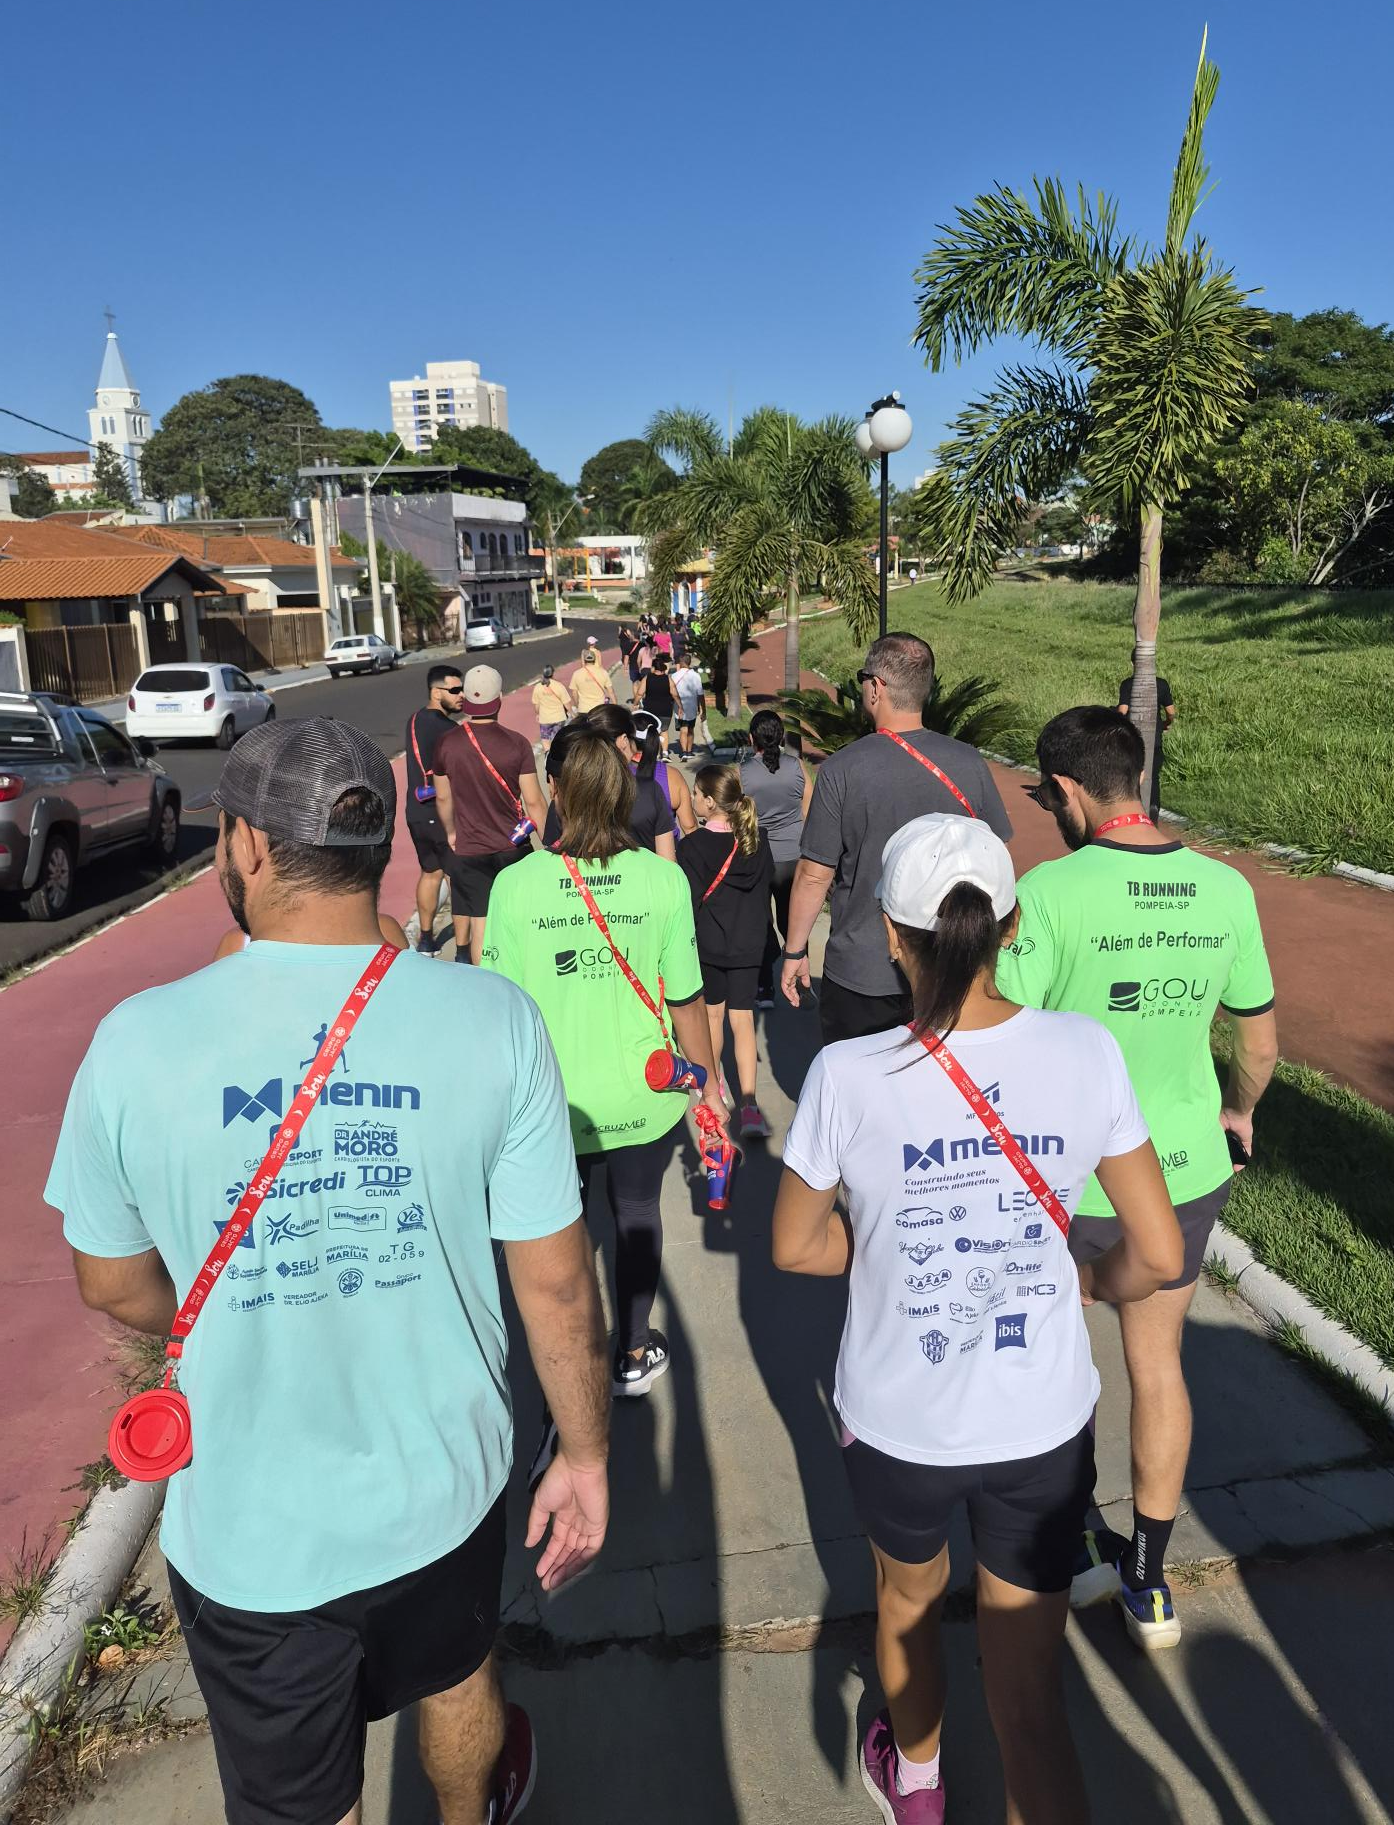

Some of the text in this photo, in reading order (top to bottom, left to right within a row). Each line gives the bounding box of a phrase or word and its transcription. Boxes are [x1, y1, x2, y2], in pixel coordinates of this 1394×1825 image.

[558, 878, 572, 890] TB
[575, 874, 622, 889] UNNING
[1127, 881, 1197, 897] TB RUNNING
[566, 888, 614, 898] POMEIA-SP
[1134, 901, 1190, 910] POMPEIA-SP
[570, 914, 585, 926] de
[1137, 933, 1153, 949] de
[1143, 978, 1209, 1002] GOU
[350, 1130, 398, 1142] ANDRÉ
[334, 1140, 399, 1157] MORO
[357, 1165, 412, 1182] TOP
[904, 1169, 987, 1186] Construindo seus
[365, 1188, 401, 1197] CLIMA
[904, 1177, 1000, 1195] melhores momentos
[333, 1211, 368, 1221] Unimed
[895, 1217, 944, 1230] comasa
[289, 1218, 320, 1231] Padilha
[326, 1248, 369, 1263] MARÍLIA
[375, 1273, 422, 1287] Passaport
[908, 1271, 949, 1288] JAZAM
[283, 1291, 317, 1300] VEREADOR
[1026, 1283, 1057, 1296] MC3
[241, 1292, 275, 1309] IMAIS
[908, 1303, 940, 1316] IMAIS
[998, 1322, 1022, 1338] ibis
[1135, 1530, 1147, 1580] OLYMPIKUS
